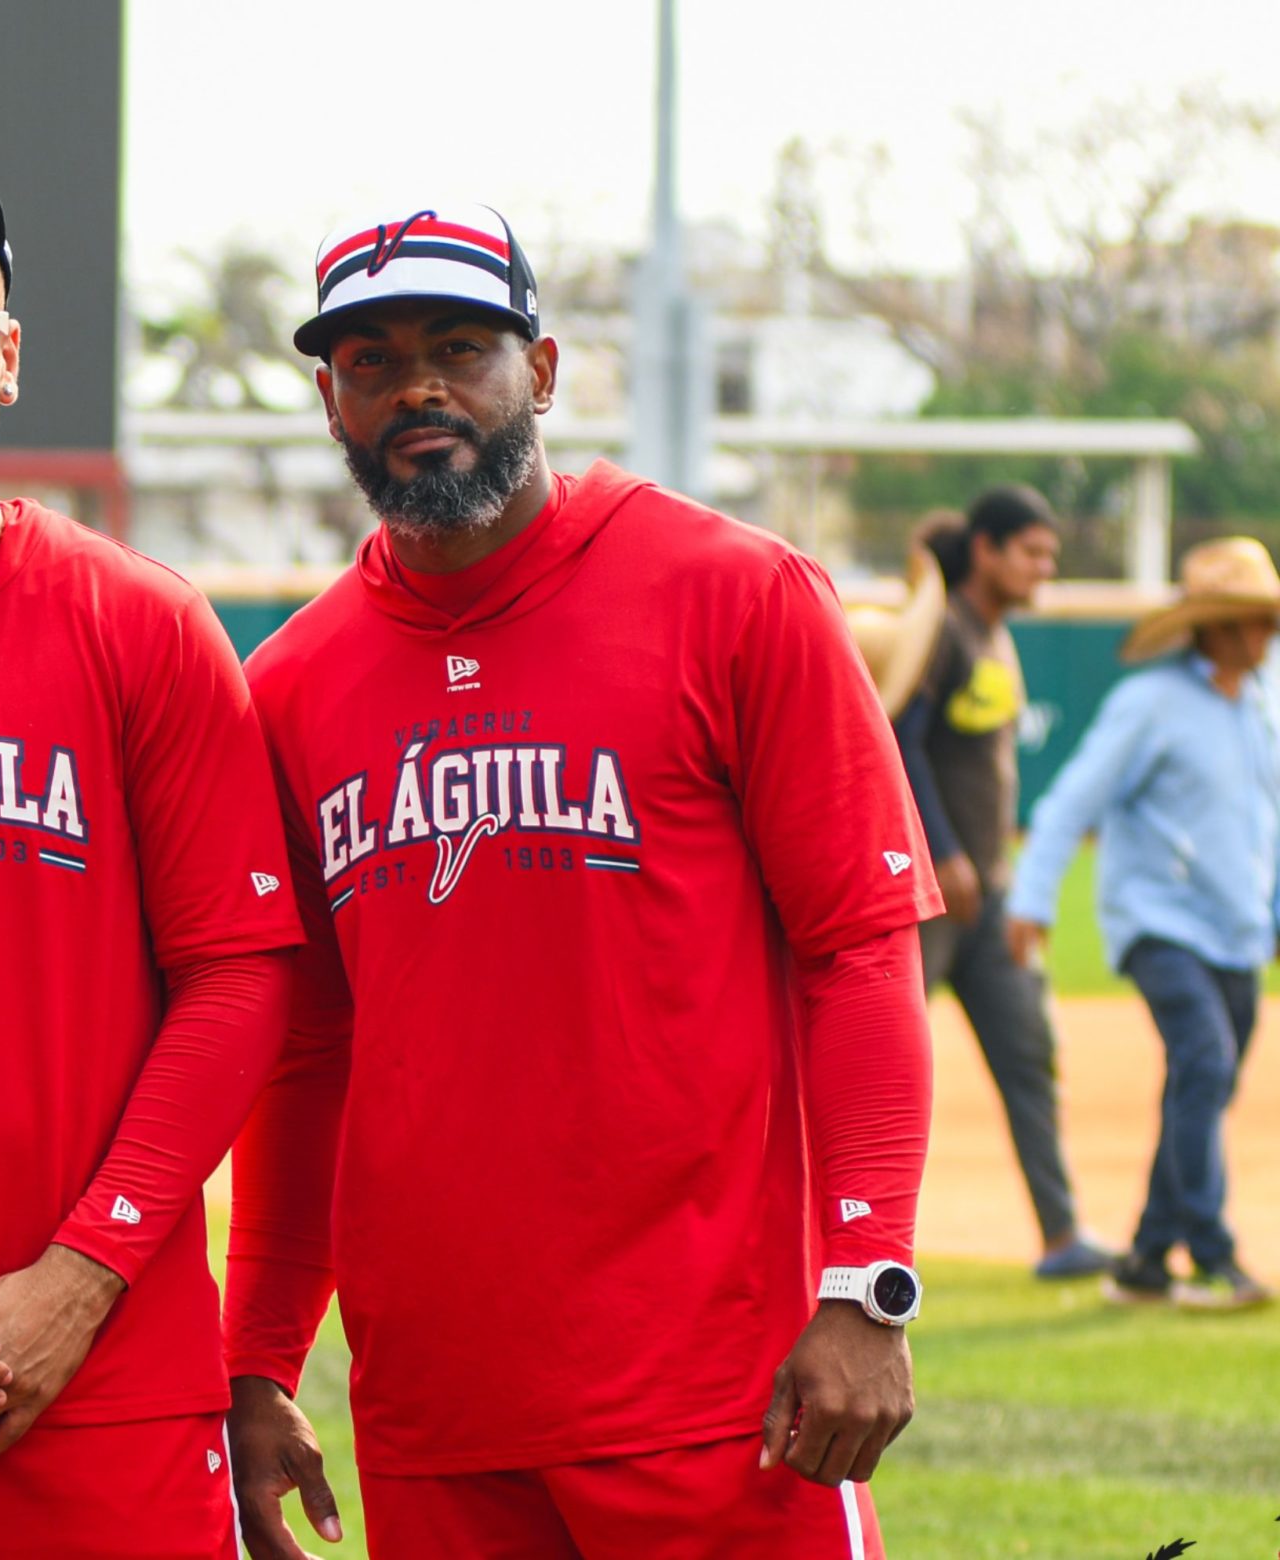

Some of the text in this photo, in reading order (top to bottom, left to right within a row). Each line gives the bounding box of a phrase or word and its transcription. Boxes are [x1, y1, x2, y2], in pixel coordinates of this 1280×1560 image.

[394, 711, 534, 747] VERACRUZ
[317, 736, 641, 886] EL ÁGUILA
[360, 849, 574, 895] EST. 1903
